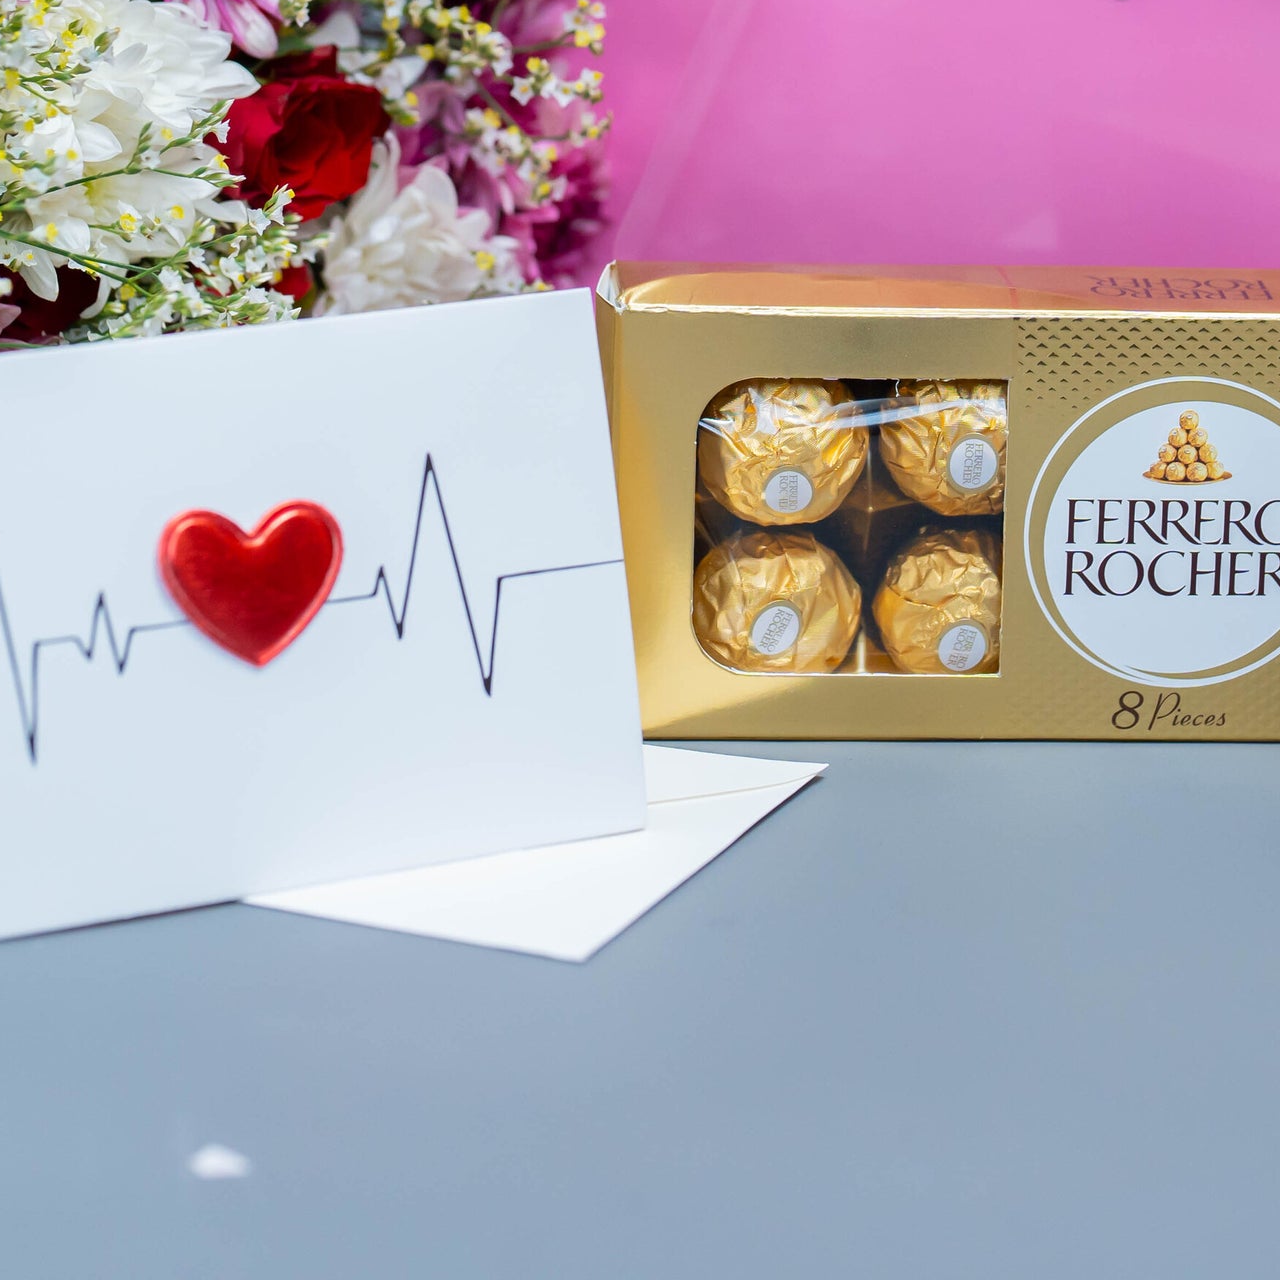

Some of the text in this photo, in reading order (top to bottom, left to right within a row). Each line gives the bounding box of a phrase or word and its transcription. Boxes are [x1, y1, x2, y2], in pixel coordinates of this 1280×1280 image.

[962, 442, 975, 485] ROCHER
[971, 442, 984, 486] FERRERO
[758, 608, 786, 649] ROCHER
[1111, 690, 1227, 732] 8 Pieces
